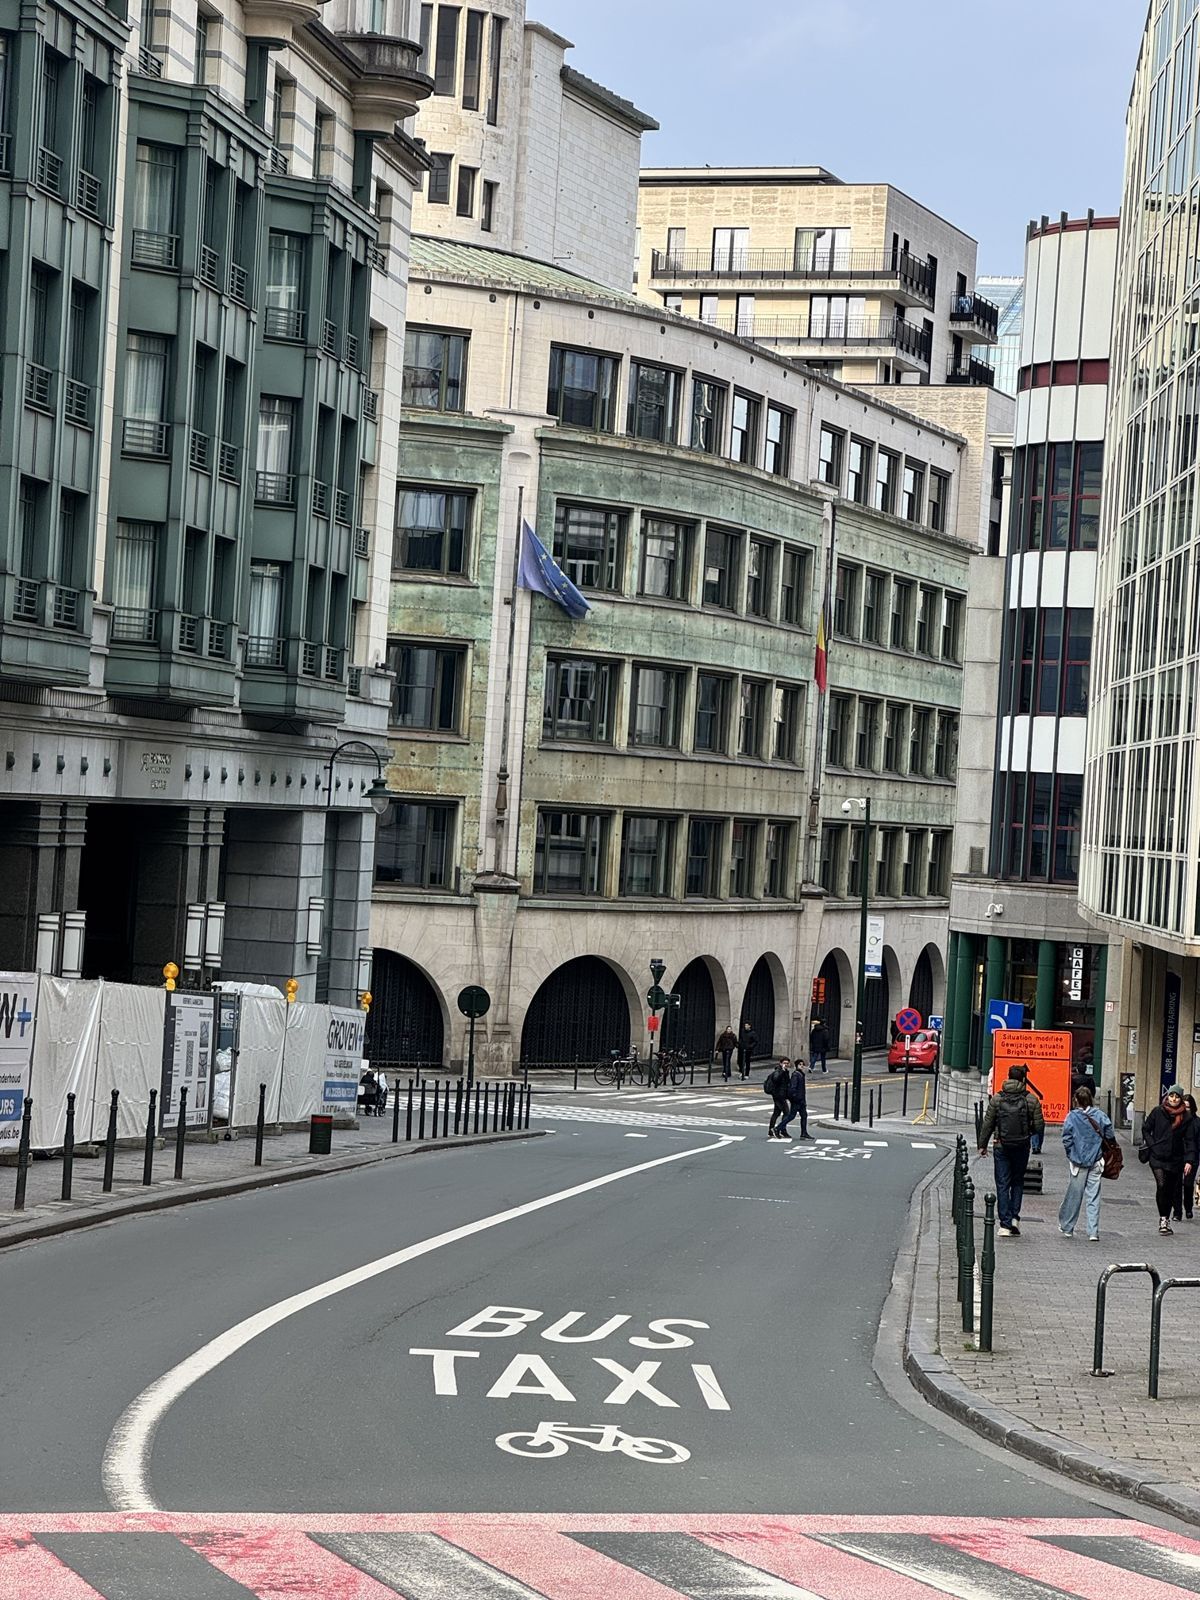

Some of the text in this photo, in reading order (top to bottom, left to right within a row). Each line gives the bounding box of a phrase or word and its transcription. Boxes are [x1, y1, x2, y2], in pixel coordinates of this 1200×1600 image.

[1073, 949, 1082, 988] CAFE
[1168, 992, 1177, 1023] PARKING
[1000, 1041, 1064, 1050] Gewijzigde situatie
[1002, 1033, 1032, 1041] Situation
[1166, 1025, 1175, 1053] PRIVATE
[1006, 1048, 1058, 1057] Bright Brussels
[1165, 1057, 1173, 1074] NBB
[783, 1149, 872, 1159] TAXI
[792, 1145, 875, 1153] BUS
[445, 1305, 710, 1349] BUS
[408, 1348, 731, 1410] TAXI
